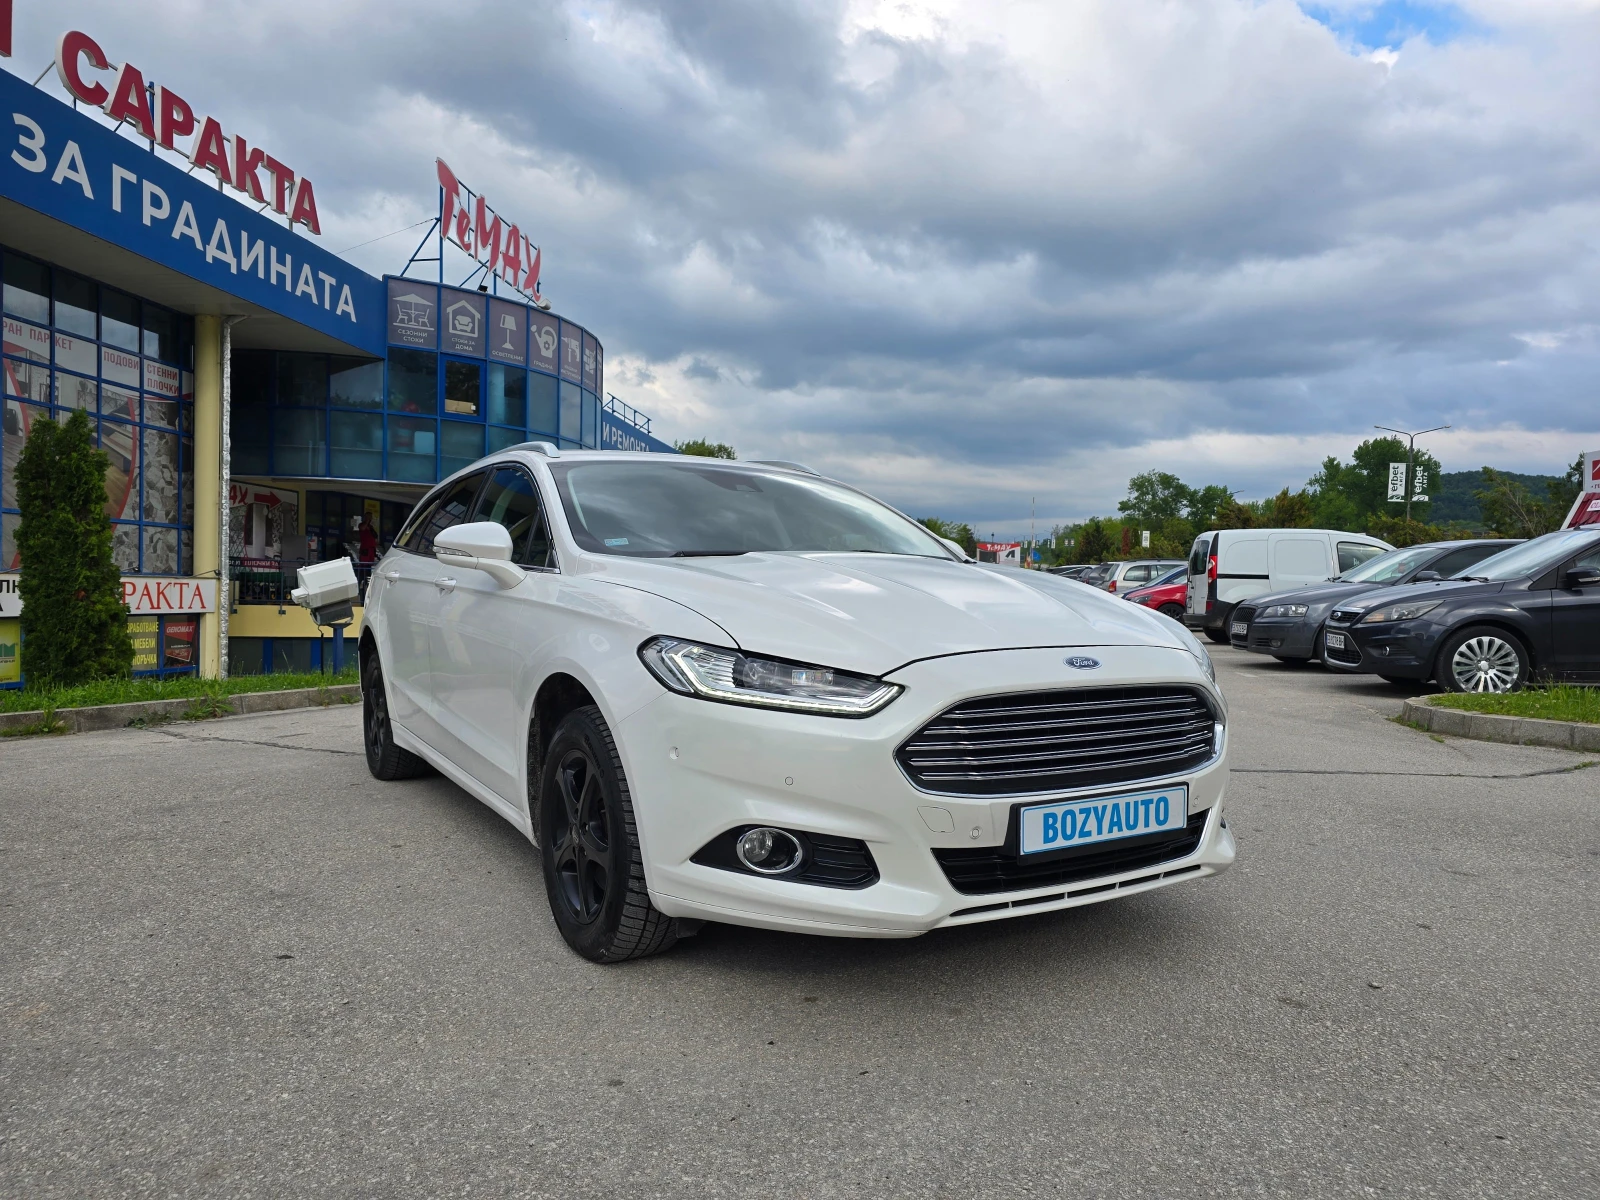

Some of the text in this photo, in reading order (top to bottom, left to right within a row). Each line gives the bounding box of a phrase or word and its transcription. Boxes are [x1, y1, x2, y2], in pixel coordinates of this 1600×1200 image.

[57, 30, 321, 235] САРАКТА
[11, 113, 357, 323] ЗА ГРАДИНАТА
[397, 328, 428, 338] СЕЗОННИ
[403, 336, 424, 344] СТОКИ
[455, 344, 473, 352] ДОМА
[491, 349, 524, 362] ОСВЕТЛЕНИЕ
[103, 351, 178, 382] ПОДОВИ СТЕННИ
[147, 377, 180, 395] ПЛОЧКИ
[1390, 465, 1399, 492] efbet
[1414, 465, 1424, 494] efbet
[126, 621, 159, 634] ЗРАБОТВАНЕ
[166, 625, 194, 634] GENOMAX
[134, 638, 156, 649] МЕБЕЛИ
[1042, 795, 1170, 845] BOZYAUTO
